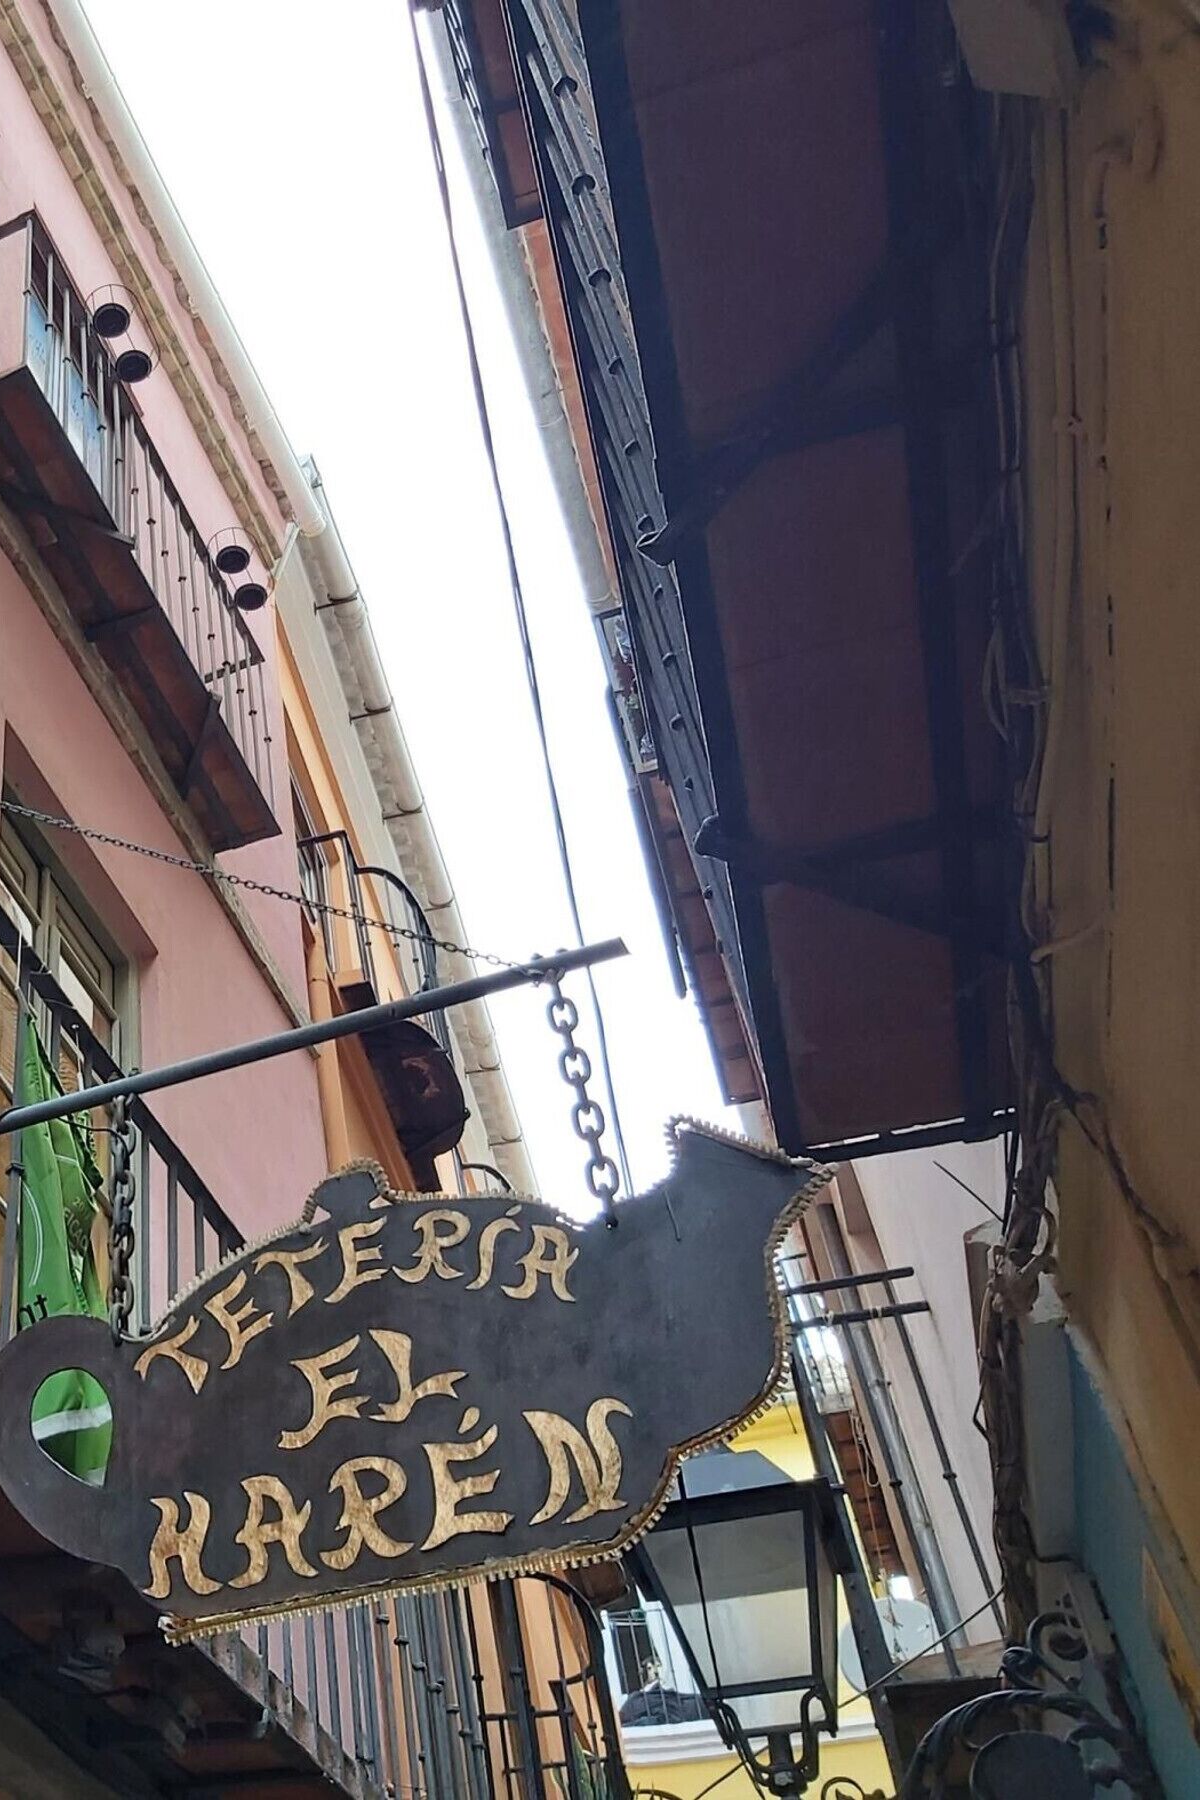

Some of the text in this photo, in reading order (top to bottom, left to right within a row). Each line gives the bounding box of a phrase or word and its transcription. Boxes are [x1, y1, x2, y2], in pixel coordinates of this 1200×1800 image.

[134, 1204, 580, 1394] TETERÍA
[277, 1328, 469, 1449] EL
[142, 1397, 634, 1599] HARÉN
